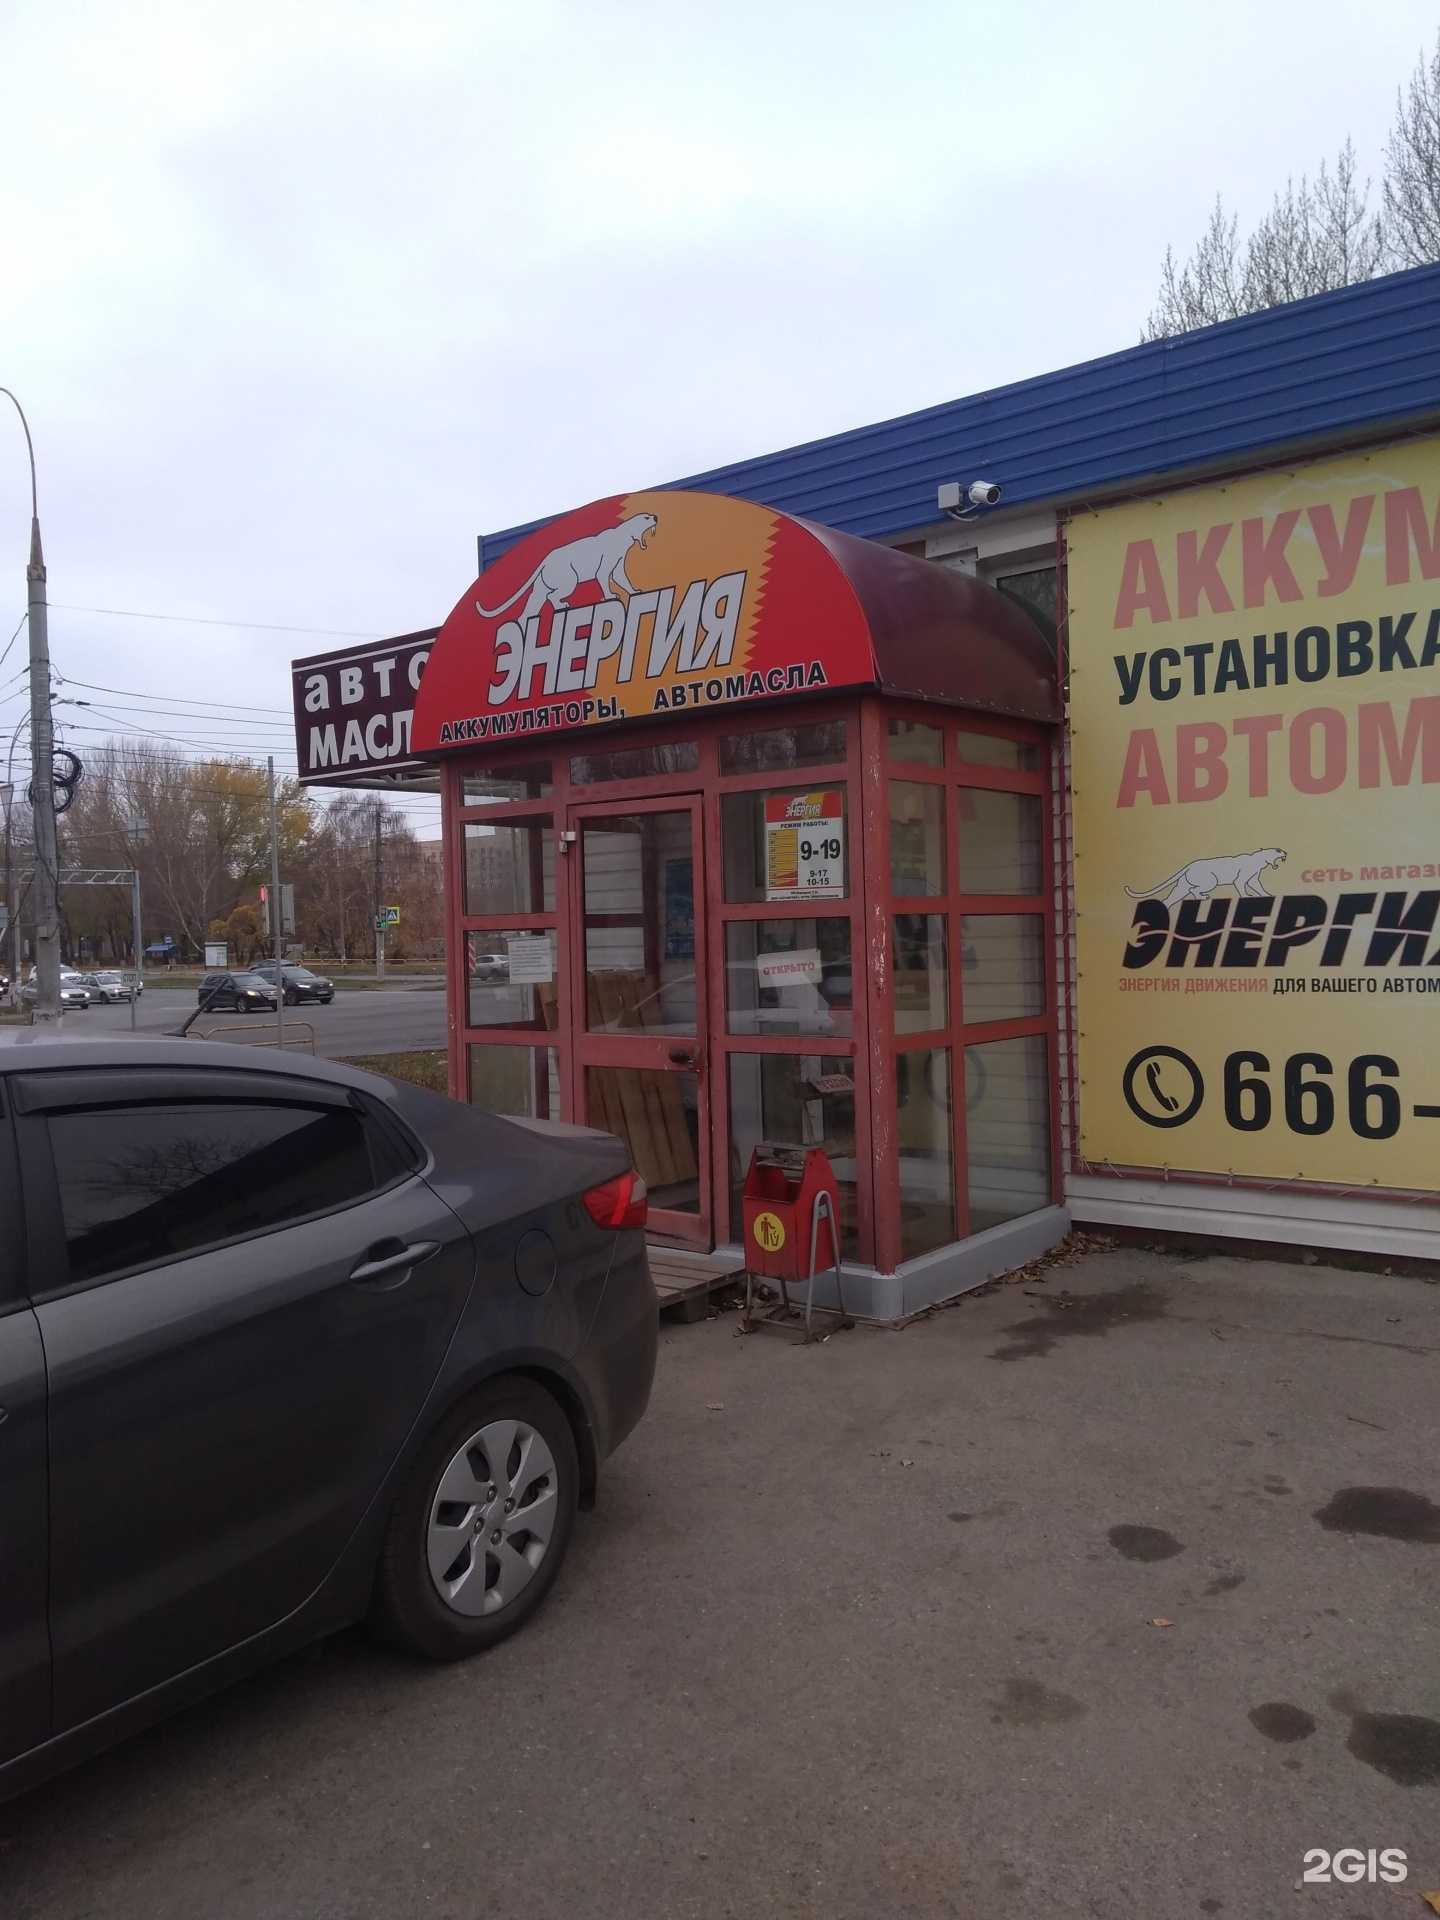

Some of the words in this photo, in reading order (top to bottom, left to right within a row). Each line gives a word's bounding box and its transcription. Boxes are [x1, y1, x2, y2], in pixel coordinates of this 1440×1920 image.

[1113, 486, 1440, 629] АККУМ
[487, 570, 748, 705] ЭНЕРГИЯ
[440, 696, 625, 744] АККУМУЛЯТОРЫ,
[654, 660, 828, 711] АВТОМАСЛА
[1116, 695, 1440, 809] АВТОМ
[800, 838, 841, 861] 9-19
[809, 869, 828, 878] 9-17
[1301, 867, 1354, 883] сеть
[807, 877, 830, 886] 10-15
[1121, 890, 1440, 969] ЭНЕРГИ
[1119, 977, 1180, 992] ЭНЕРГИЯ
[1184, 977, 1268, 993] ДВИЖЕНИЯ
[1273, 977, 1306, 994] ДЛЯ
[1311, 978, 1377, 993] ВАШЕГО
[1382, 978, 1440, 993] АВТОМ
